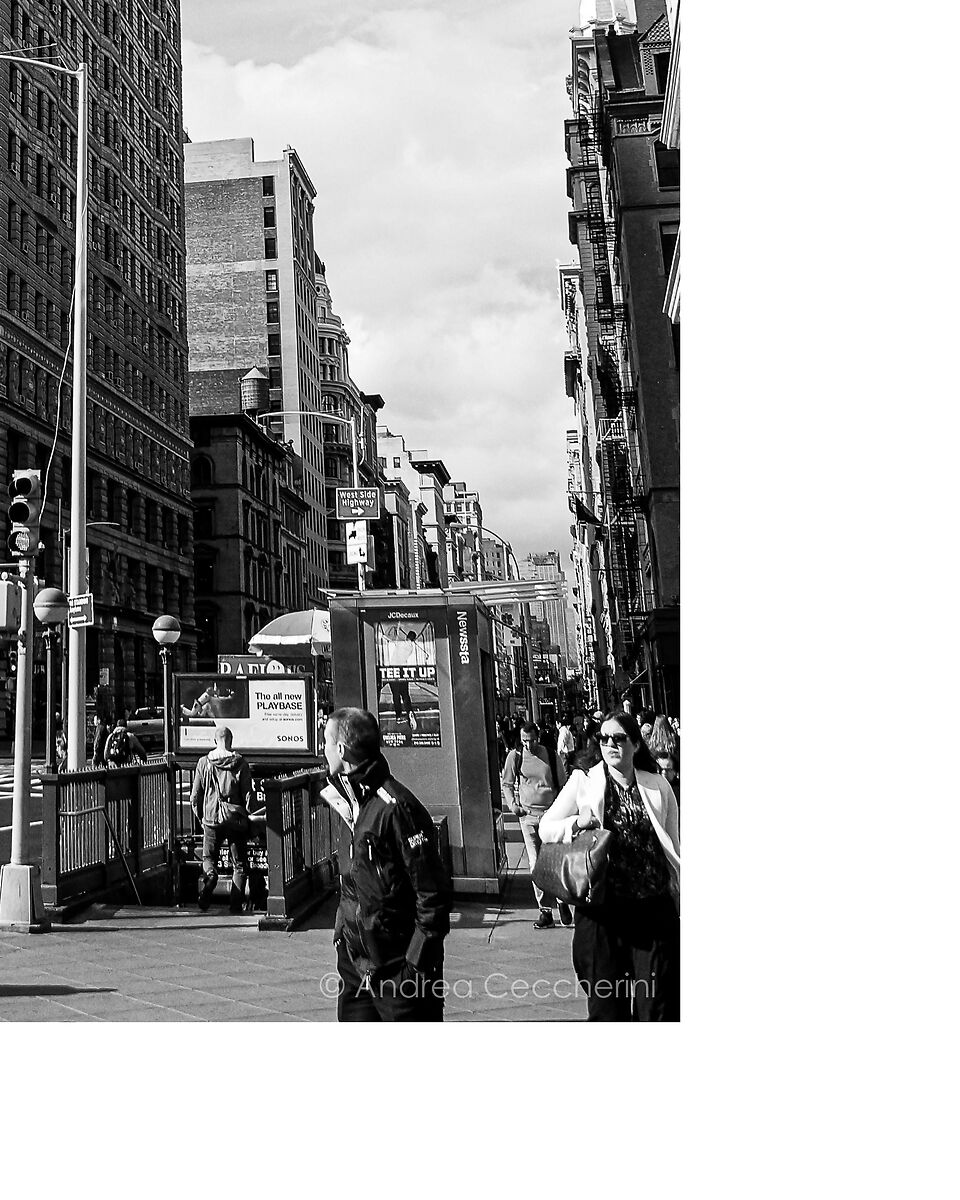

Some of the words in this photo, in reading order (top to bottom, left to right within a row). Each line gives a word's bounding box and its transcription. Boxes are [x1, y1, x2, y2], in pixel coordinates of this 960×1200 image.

[339, 491, 359, 499] West
[359, 490, 377, 499] Side
[342, 499, 375, 508] Highway
[387, 611, 420, 619] JCDecaux
[379, 667, 401, 679] TEE
[402, 666, 417, 679] IT
[418, 666, 436, 678] UP
[254, 692, 271, 701] The
[272, 692, 283, 701] all
[284, 693, 303, 701] new
[256, 701, 304, 710] PLAYBASE
